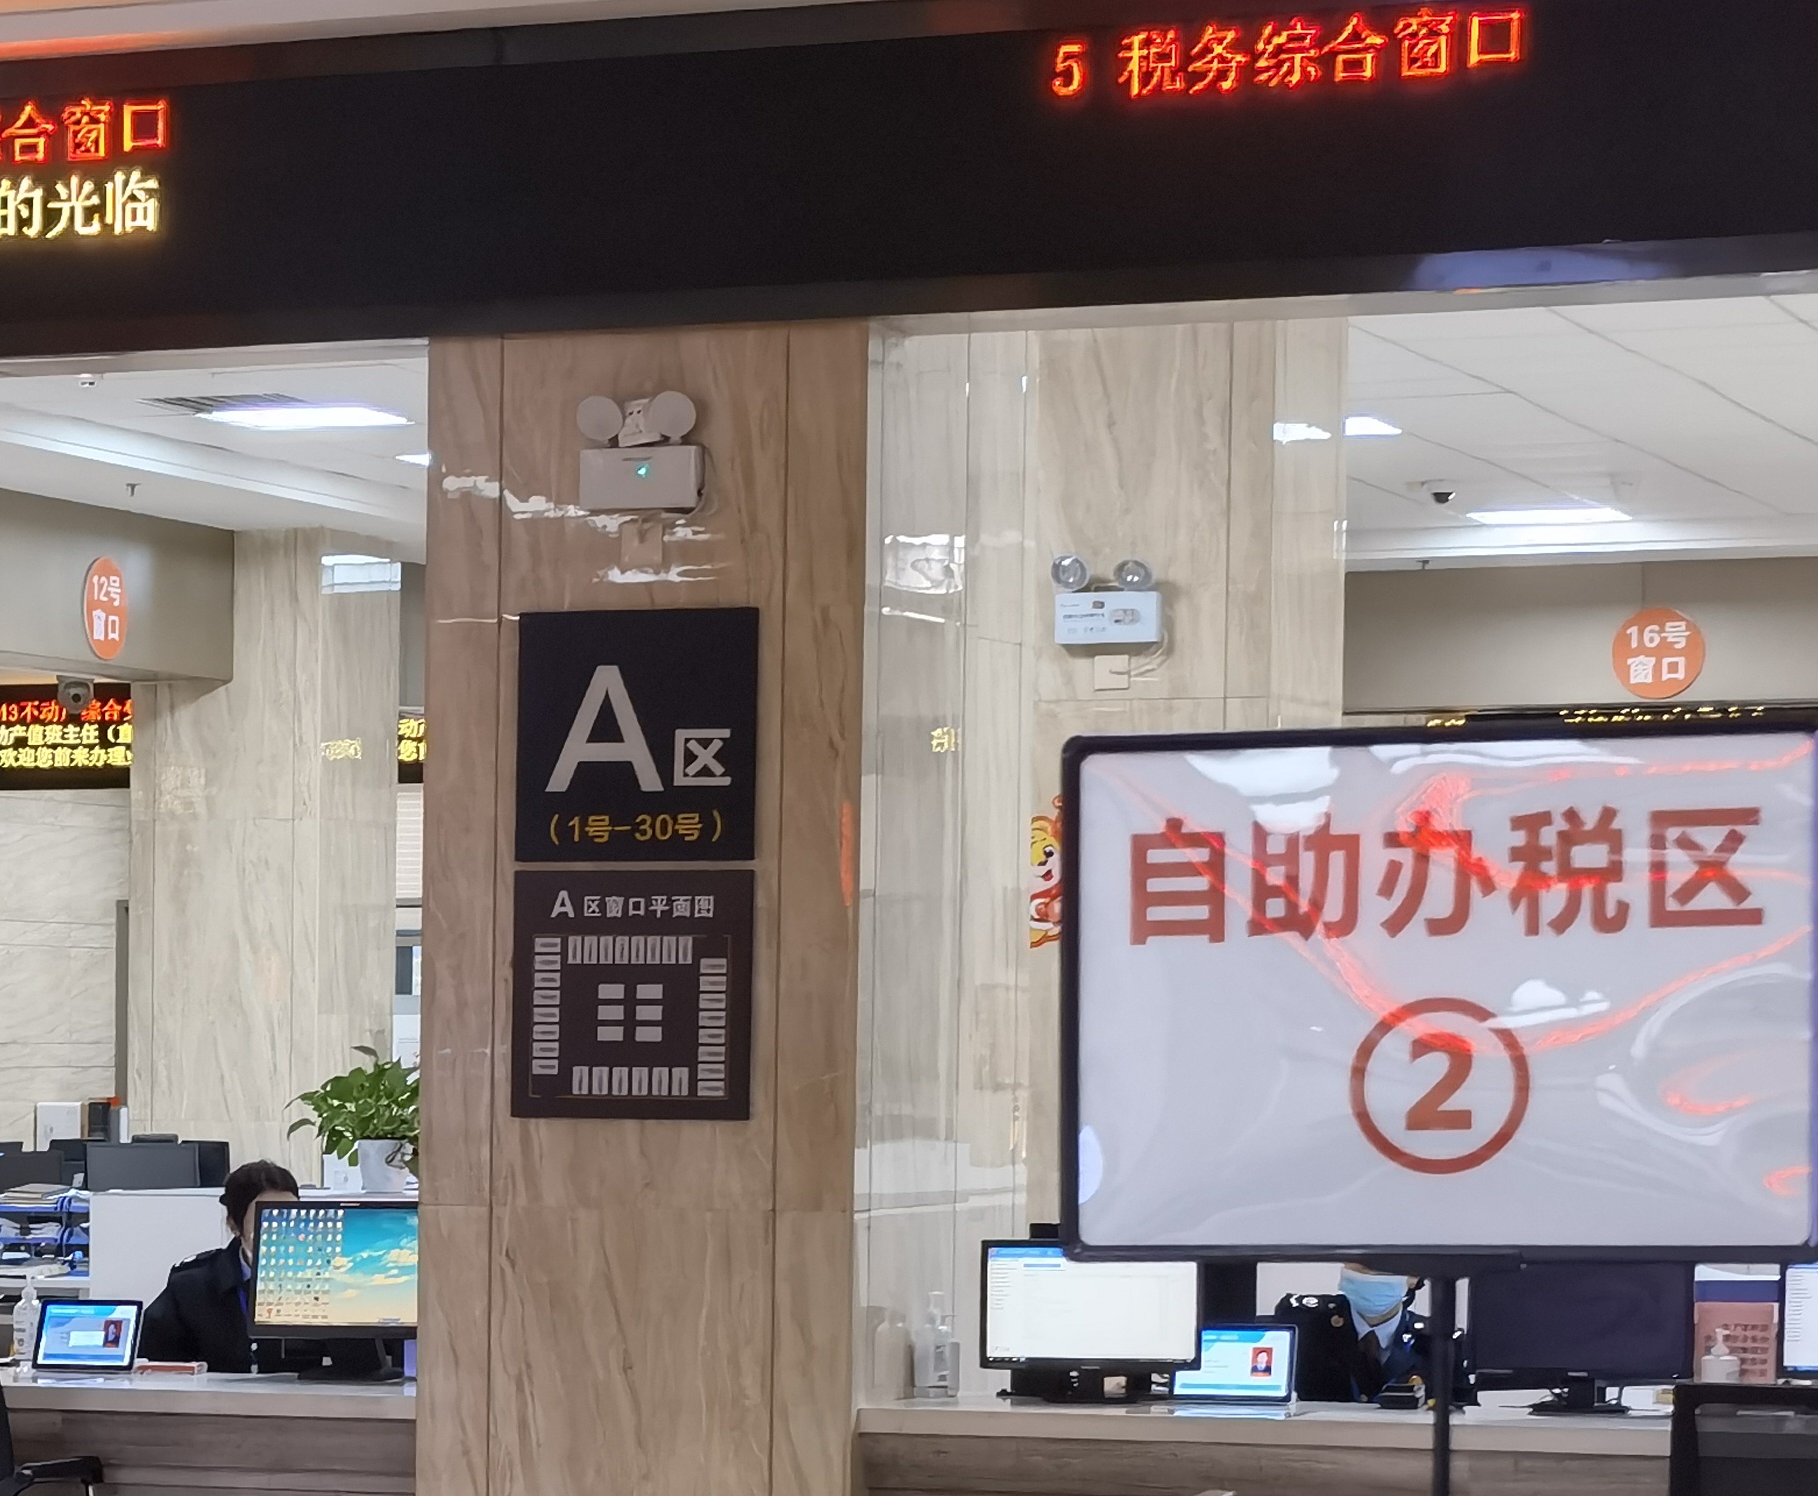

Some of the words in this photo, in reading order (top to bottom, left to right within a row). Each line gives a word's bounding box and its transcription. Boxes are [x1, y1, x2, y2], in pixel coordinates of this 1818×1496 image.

[1051, 41, 1084, 97] 5
[1117, 7, 1524, 98] 税务综合窗口
[91, 574, 122, 607] 12号
[92, 609, 120, 641] 窗口
[1625, 621, 1691, 649] 16号
[1626, 655, 1686, 684] 窗口
[0, 746, 133, 768] 欢迎您前来办理
[1128, 804, 1764, 946] 自助办税区
